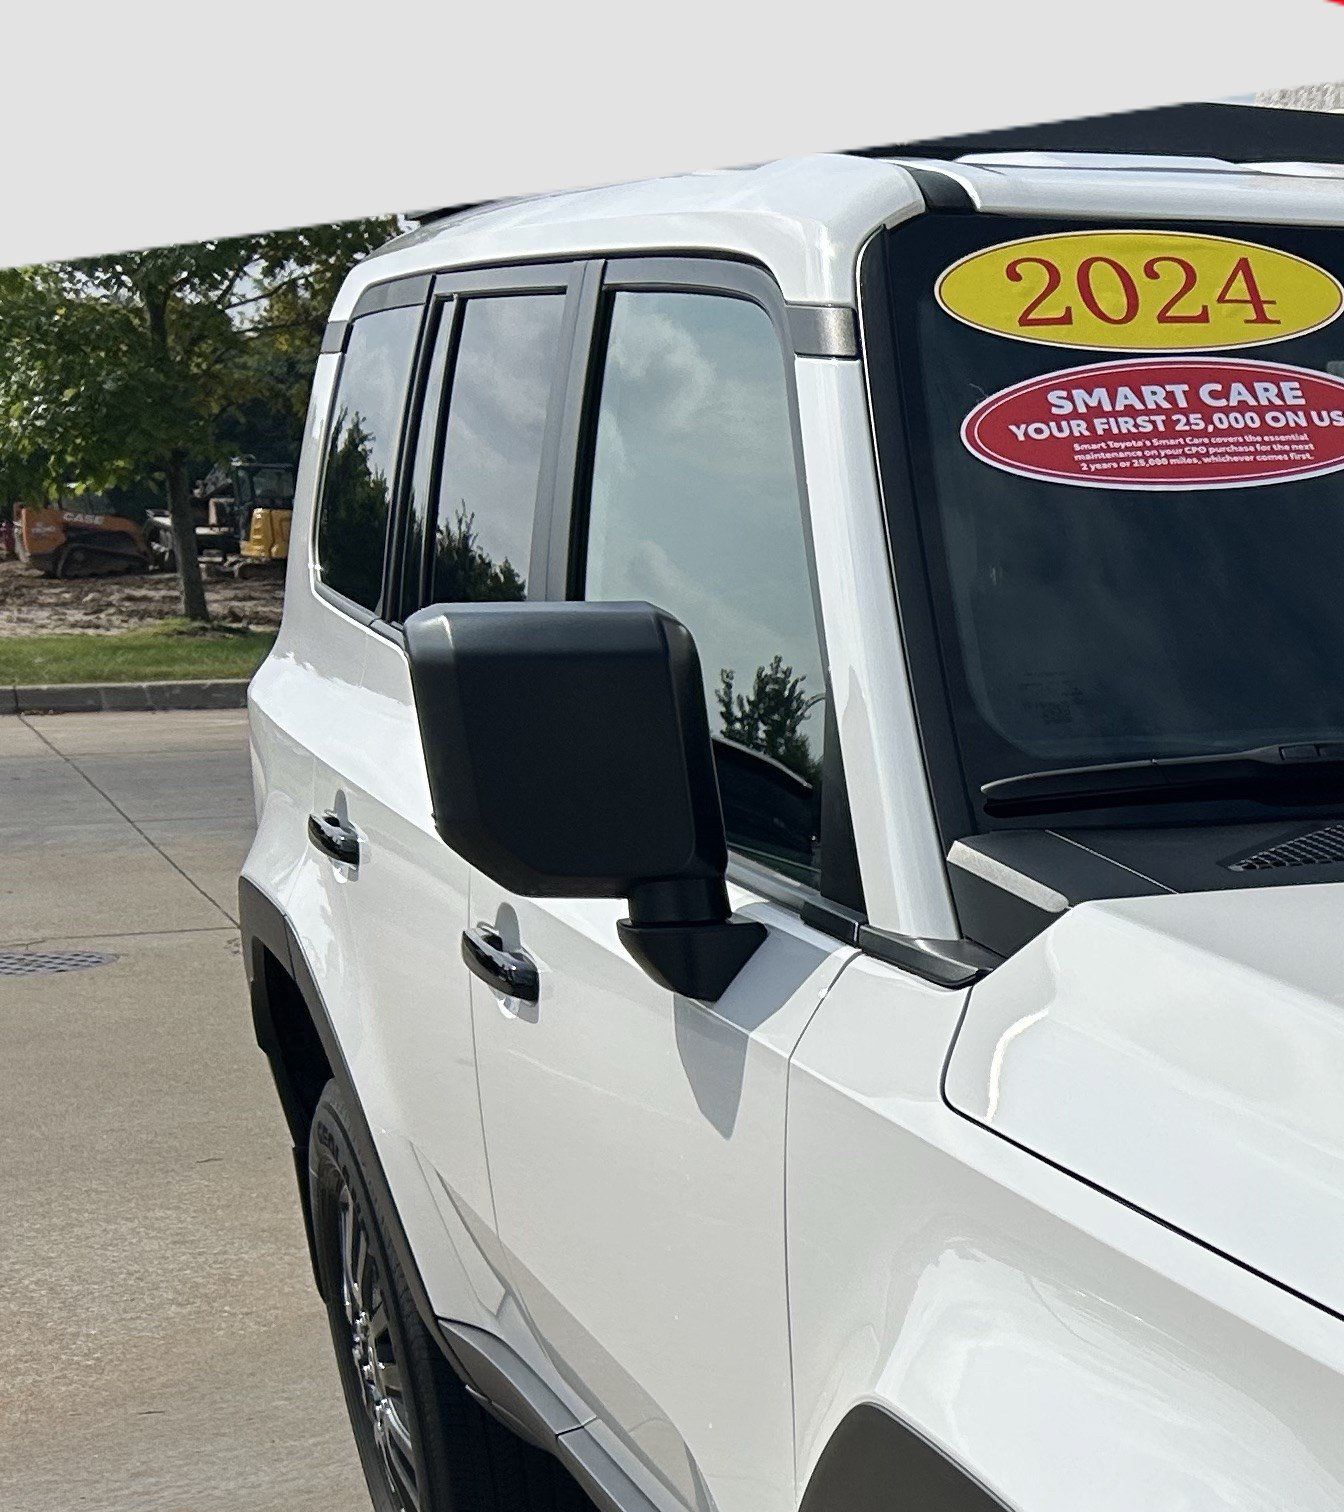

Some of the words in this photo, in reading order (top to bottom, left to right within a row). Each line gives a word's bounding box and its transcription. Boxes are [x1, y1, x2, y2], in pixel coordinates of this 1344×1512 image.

[1004, 255, 1282, 327] 2024
[1046, 383, 1190, 415] SMART
[1198, 381, 1306, 407] CARE
[1008, 419, 1091, 442] YOUR
[1092, 414, 1166, 436] FIRST
[1171, 411, 1261, 433] 25,000
[1264, 410, 1309, 429] ON
[1073, 442, 1107, 451] Smart
[1107, 439, 1151, 449] Toyota's
[1152, 438, 1184, 446] Smart
[1185, 437, 1209, 445] Care
[1244, 434, 1262, 442] the
[1263, 433, 1309, 441] essential
[1073, 450, 1143, 461] maintenance
[1159, 448, 1183, 457] your
[1184, 446, 1207, 454] CPO
[1208, 445, 1255, 454] purchase
[1255, 443, 1271, 451] for
[1272, 443, 1290, 451] the
[1291, 443, 1315, 451] next
[1080, 462, 1089, 471] 2
[1089, 462, 1118, 472] years
[1131, 457, 1169, 468] 25,000
[1169, 456, 1202, 465] miles,
[1202, 455, 1255, 463] whichever
